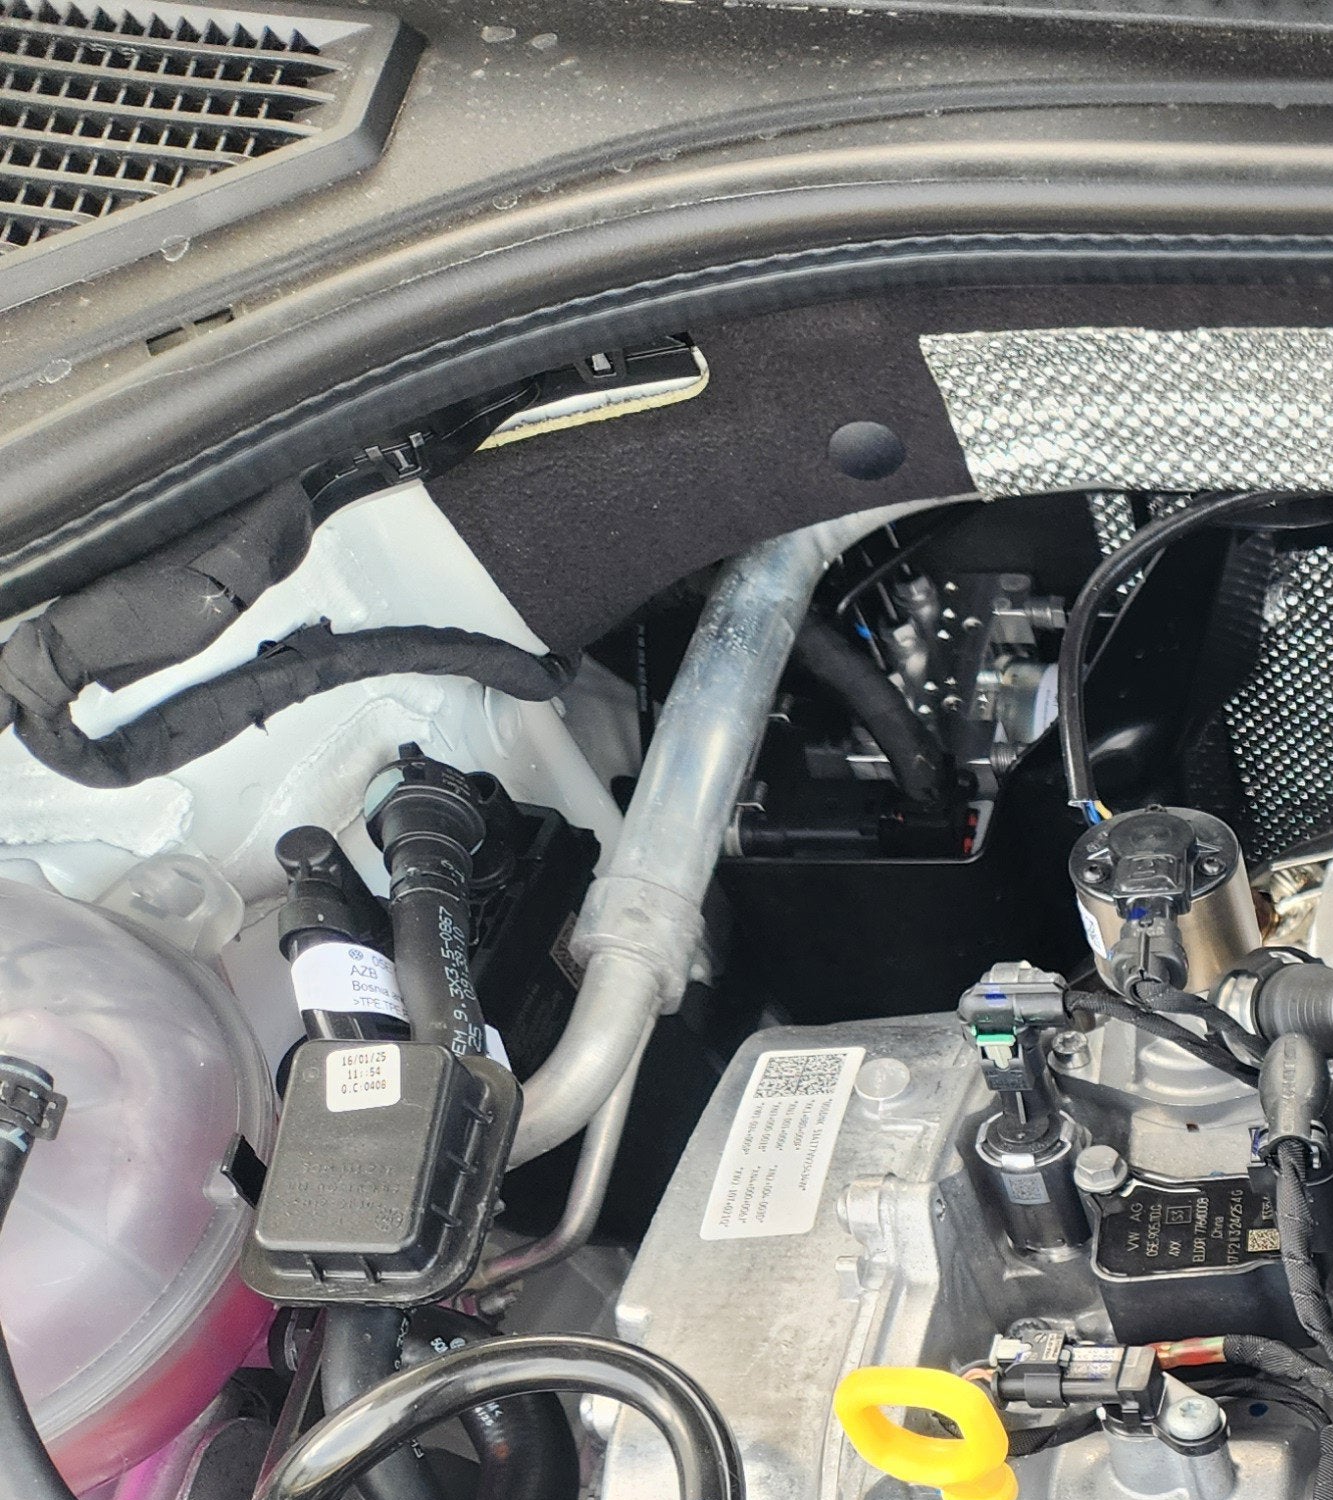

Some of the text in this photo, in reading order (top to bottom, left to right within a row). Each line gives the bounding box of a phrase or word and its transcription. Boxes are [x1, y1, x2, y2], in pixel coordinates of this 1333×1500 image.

[350, 964, 378, 980] AZB
[352, 980, 390, 997] Bosnia
[342, 1051, 387, 1067] 16/01/25
[1126, 1203, 1144, 1252] VW AG
[1211, 1216, 1225, 1239] China
